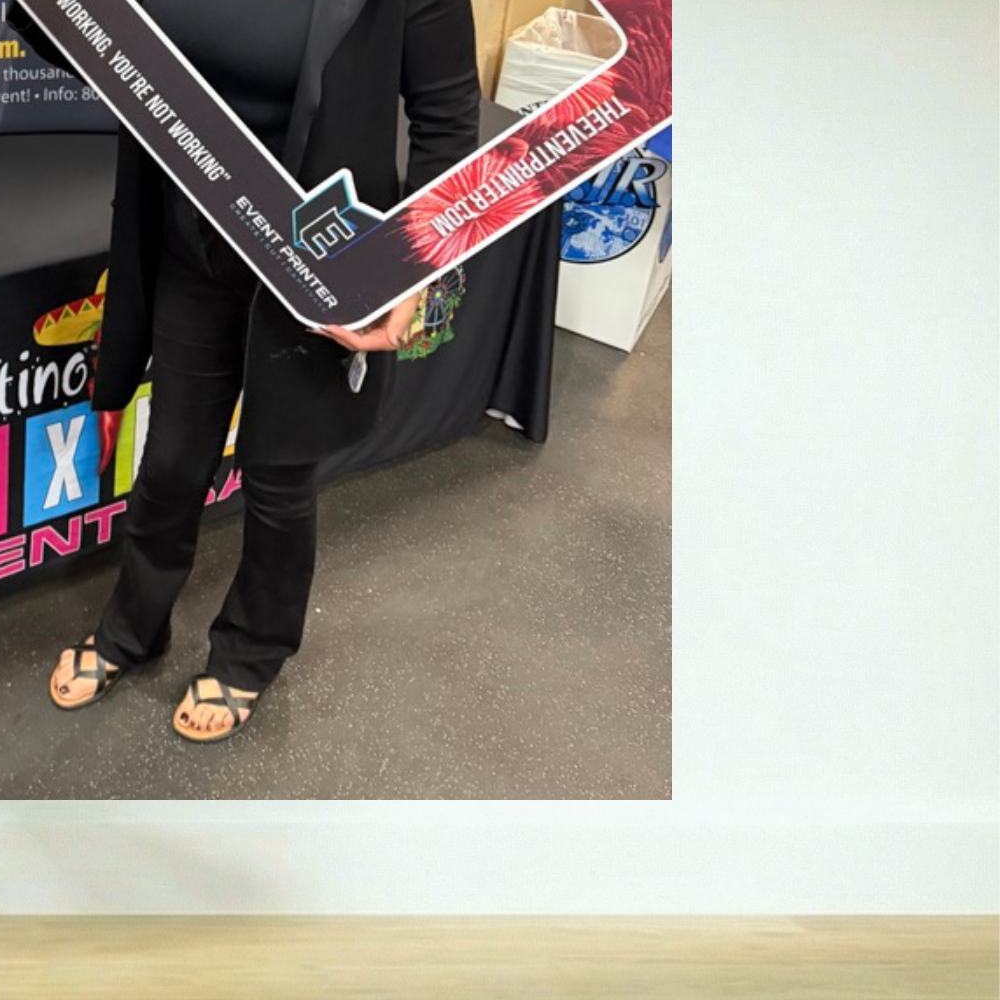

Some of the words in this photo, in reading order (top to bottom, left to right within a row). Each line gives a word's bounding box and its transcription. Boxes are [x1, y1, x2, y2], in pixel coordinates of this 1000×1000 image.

[43, 86, 78, 102] Info:
[107, 49, 155, 102] YOU'RE
[144, 93, 177, 125] NOT
[430, 96, 632, 238] THEEVENTPRINTER.COM
[235, 195, 284, 244] EVENT
[279, 244, 339, 309] PRINTER
